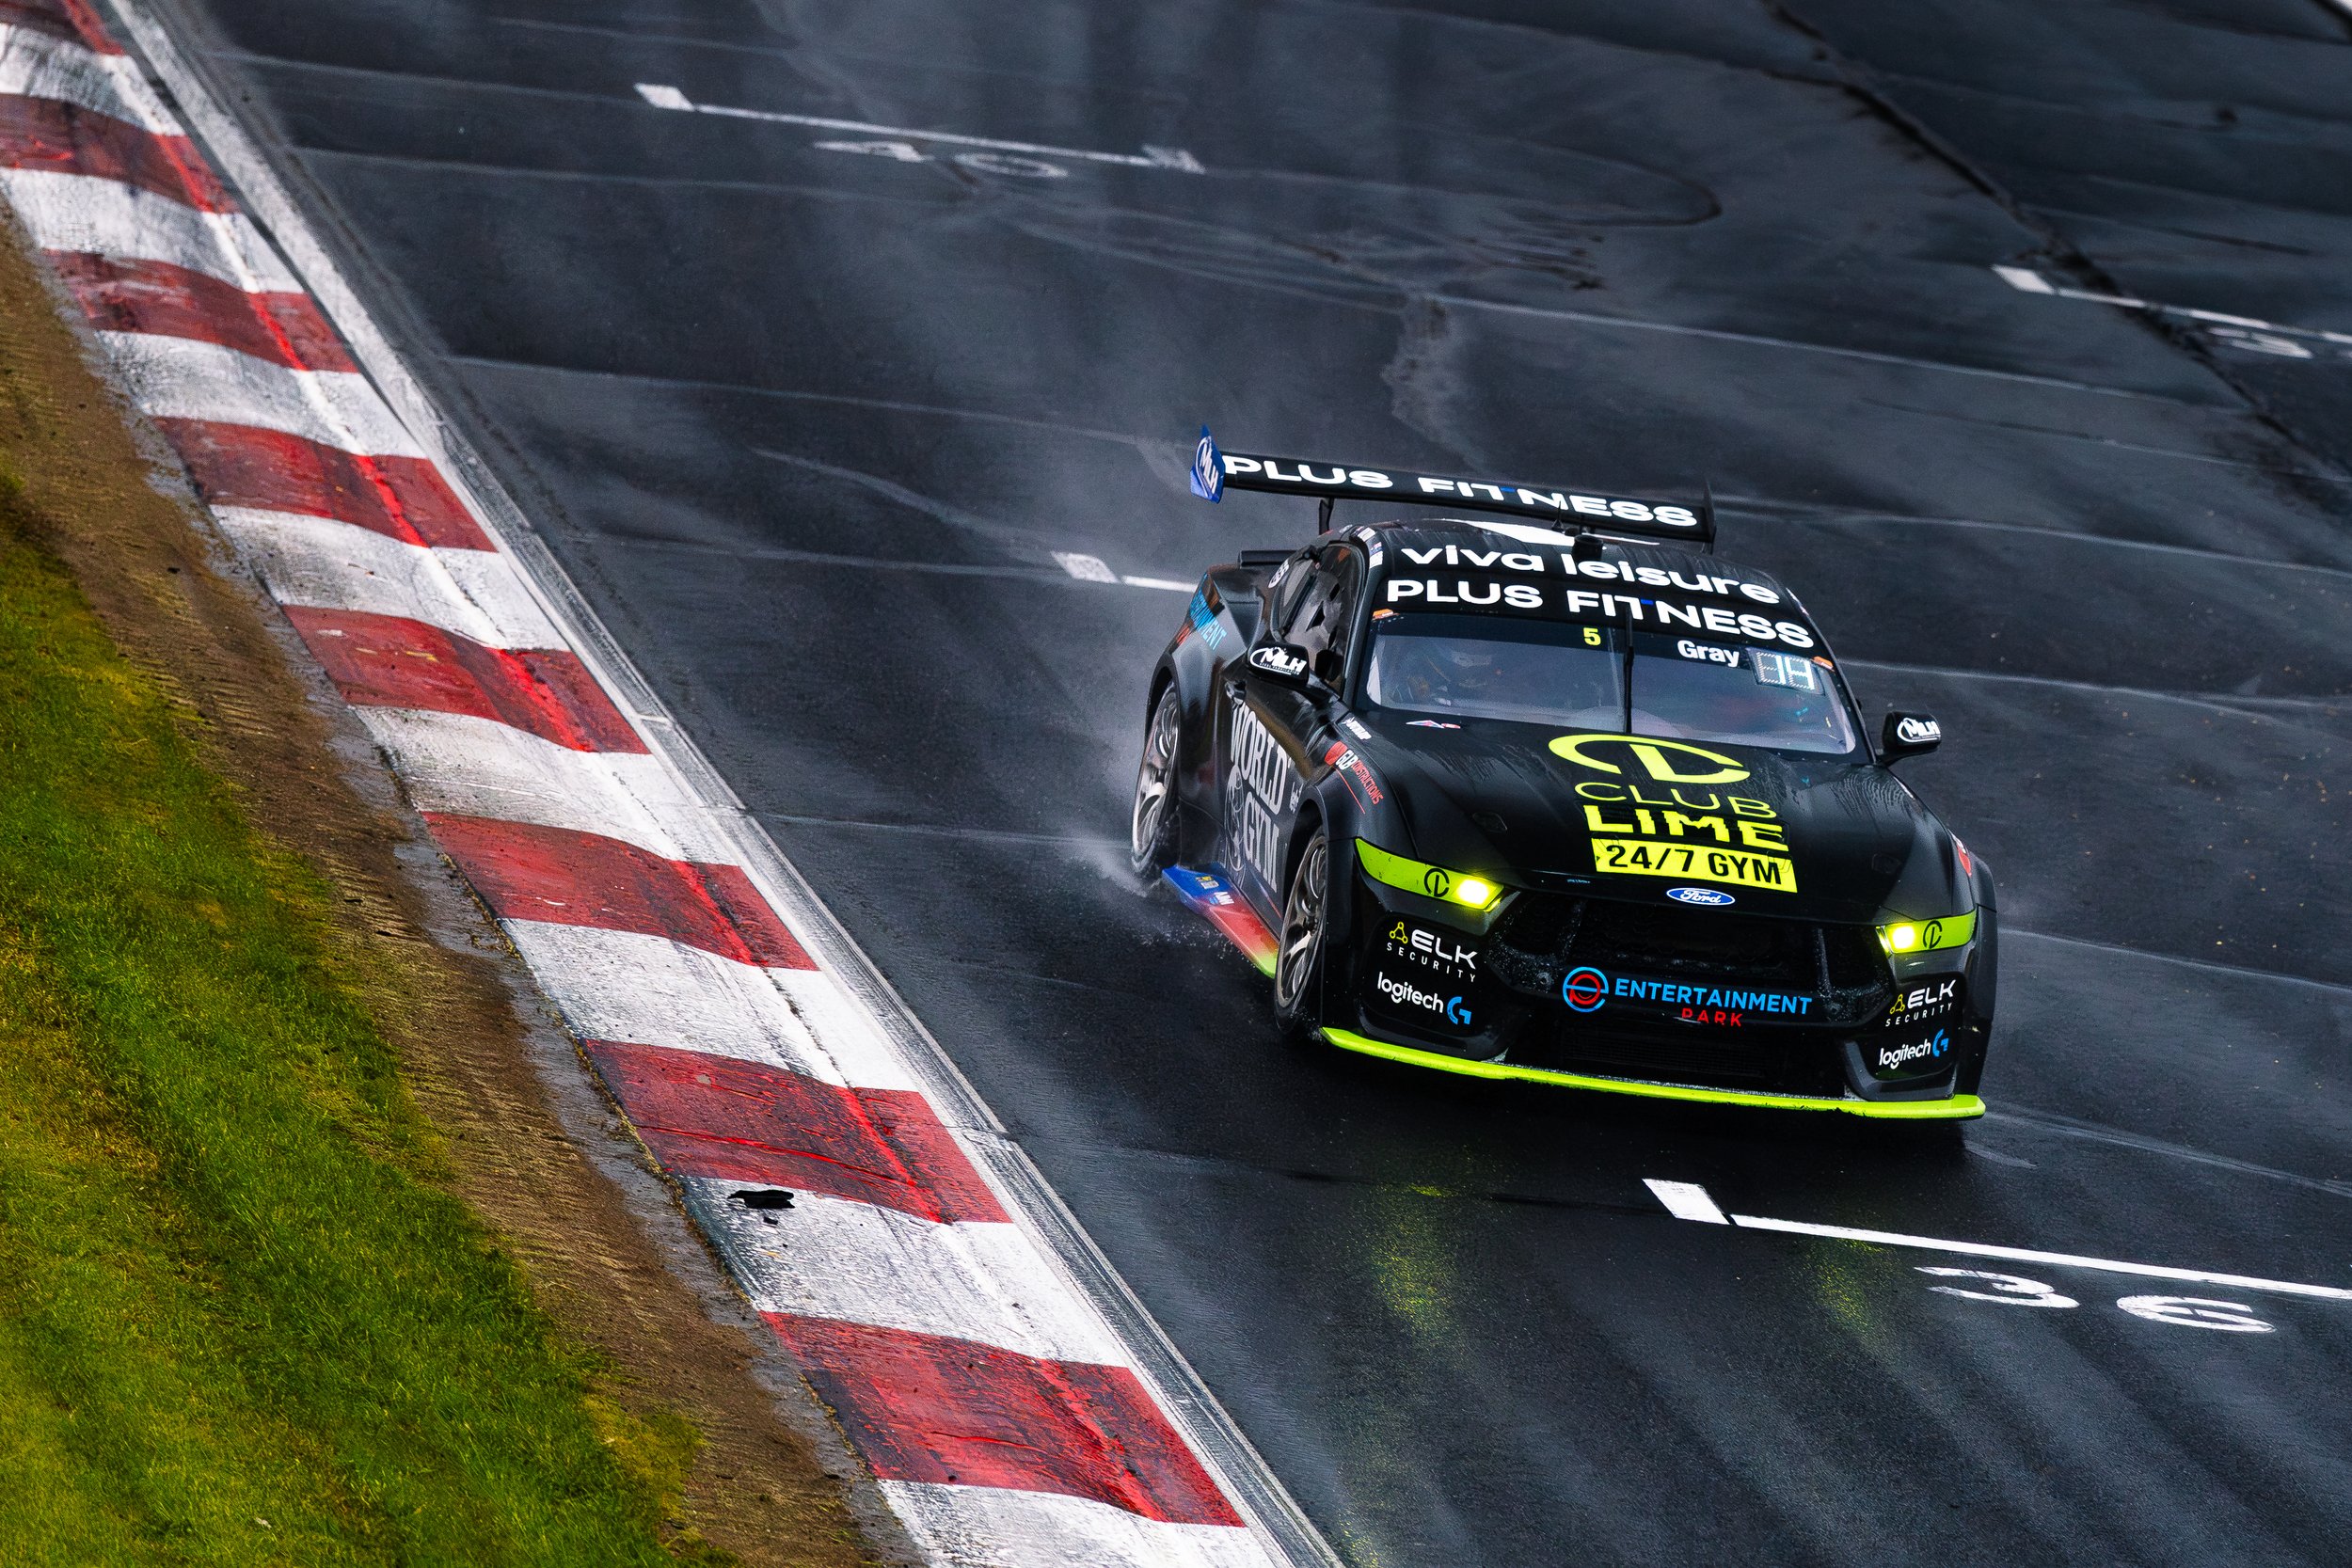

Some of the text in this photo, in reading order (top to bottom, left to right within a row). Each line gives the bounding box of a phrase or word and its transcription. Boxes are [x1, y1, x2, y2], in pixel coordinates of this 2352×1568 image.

[1221, 454, 1697, 528] PLUS FITNESS
[1401, 545, 1545, 572] viva
[1561, 553, 1780, 605] leisure
[1387, 579, 1815, 649] PLUS FITNESS
[1582, 626, 1602, 647] 5
[1677, 639, 1740, 668] Gray
[1259, 646, 1308, 674] MLH
[1903, 721, 1941, 737] MLH
[1231, 701, 1289, 816] WORLD
[1574, 782, 1777, 818] CLUB
[1243, 791, 1280, 895] GYM
[1583, 804, 1789, 852] LIME
[1605, 844, 1783, 886] 24/7 GYM
[1679, 888, 1723, 904] Ford
[1386, 942, 1476, 983] SECURITY
[1411, 928, 1478, 970] ELK
[1376, 971, 1444, 1014] logitech
[1613, 977, 1813, 1015] ENTERTAINMENT
[1907, 979, 1957, 1009] ELK
[1681, 1007, 1744, 1027] PARK
[1884, 1002, 1953, 1027] SECURITY
[1878, 1037, 1931, 1070] logitech
[1914, 1266, 2276, 1334] 36
